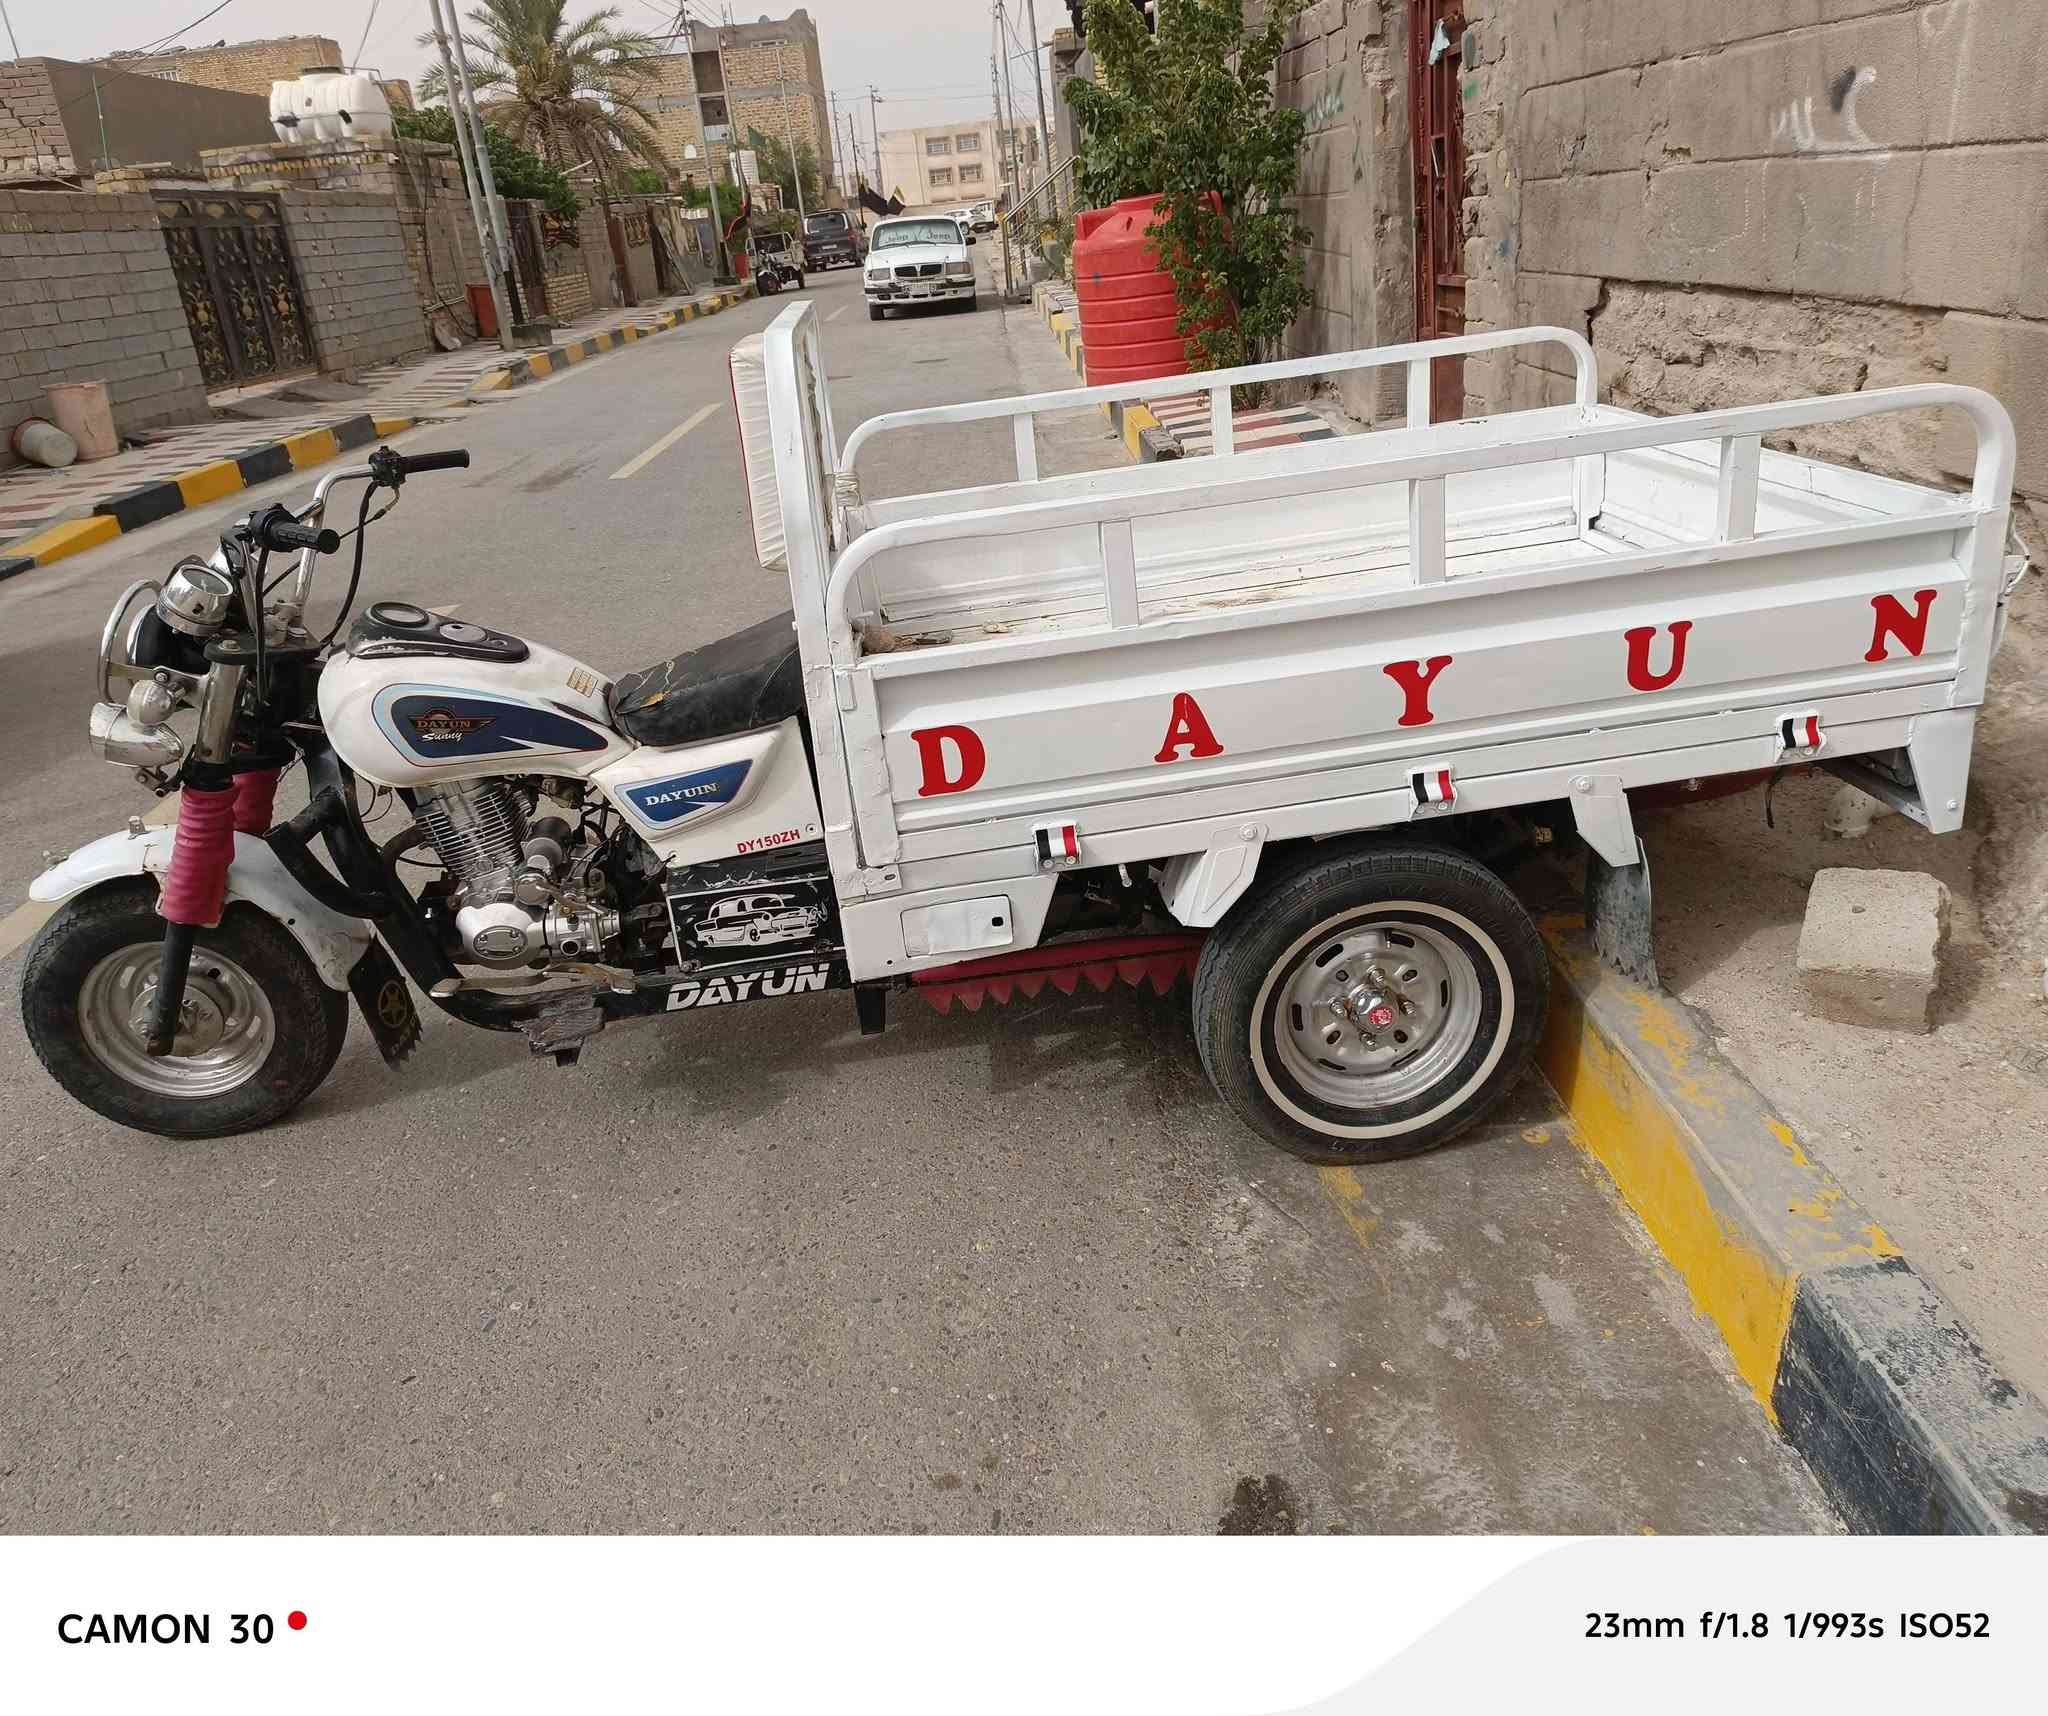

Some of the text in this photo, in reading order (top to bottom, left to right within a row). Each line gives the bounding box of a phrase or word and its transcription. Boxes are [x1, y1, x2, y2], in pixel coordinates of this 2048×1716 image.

[417, 719, 471, 728] DAYUN
[736, 829, 801, 854] DY150ZH
[665, 962, 831, 1012] DAYUN
